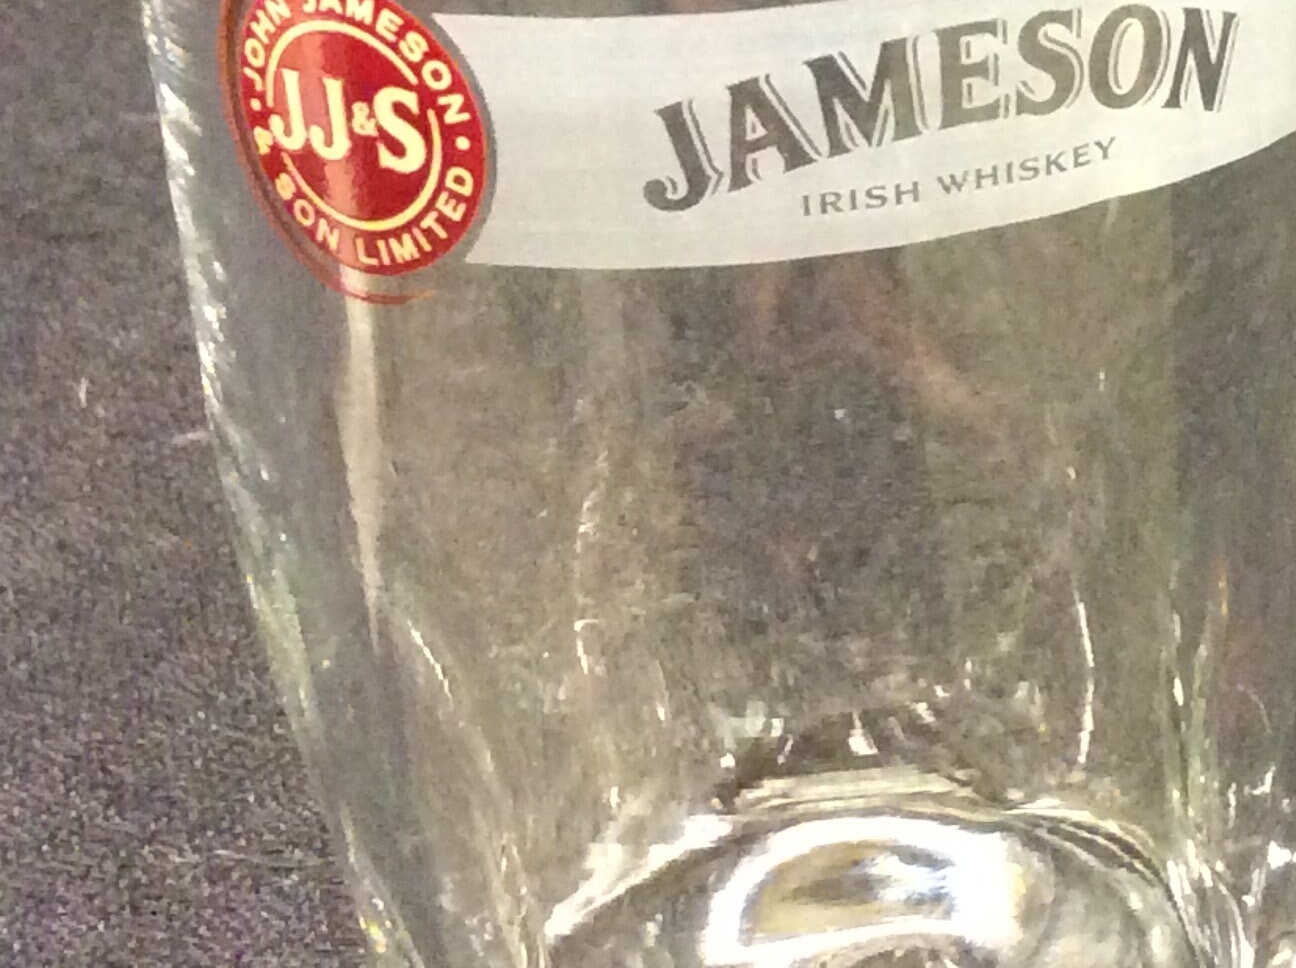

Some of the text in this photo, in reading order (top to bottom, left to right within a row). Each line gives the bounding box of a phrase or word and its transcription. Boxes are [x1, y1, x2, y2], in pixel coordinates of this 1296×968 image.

[269, 67, 428, 174] JJ&S
[643, 3, 1239, 213] JAMESON
[275, 167, 474, 266] SON LIMITED
[802, 136, 1117, 217] IRISH WHISKEY
